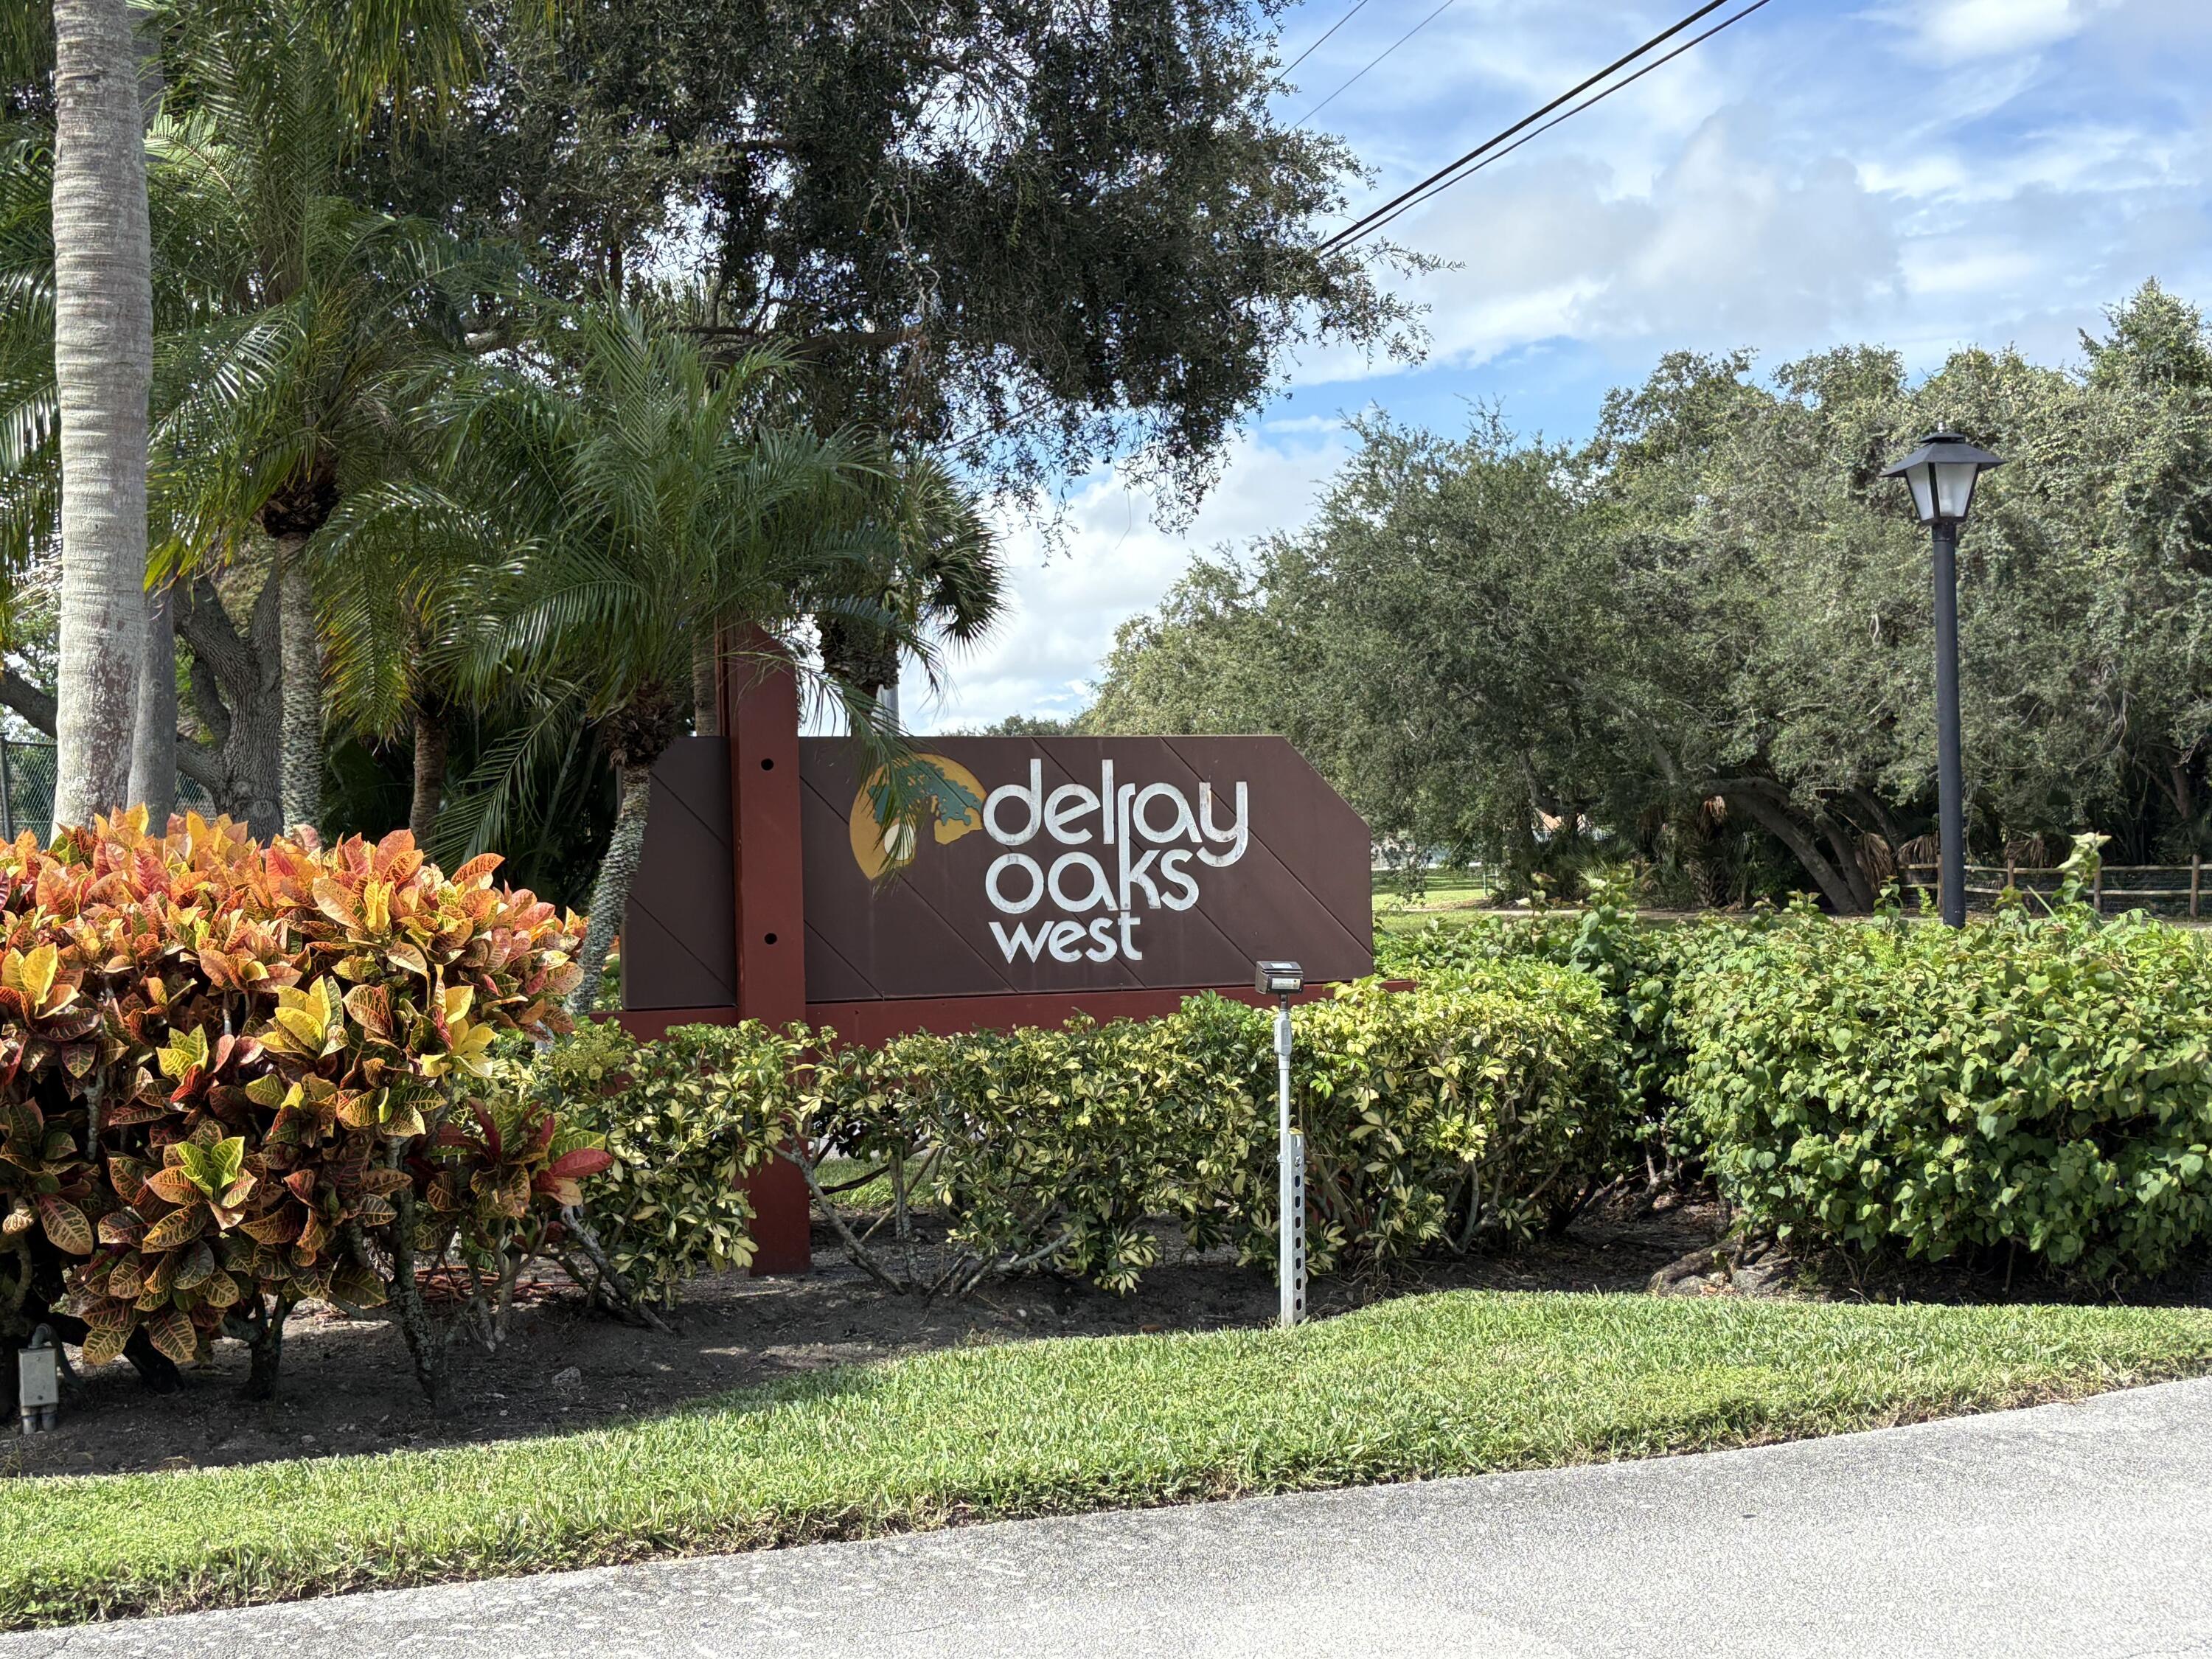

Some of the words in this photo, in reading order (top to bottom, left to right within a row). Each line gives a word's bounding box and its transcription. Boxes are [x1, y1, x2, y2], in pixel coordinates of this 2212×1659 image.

[983, 758, 1248, 868] delray
[985, 849, 1200, 914] oaks
[988, 911, 1143, 964] west
